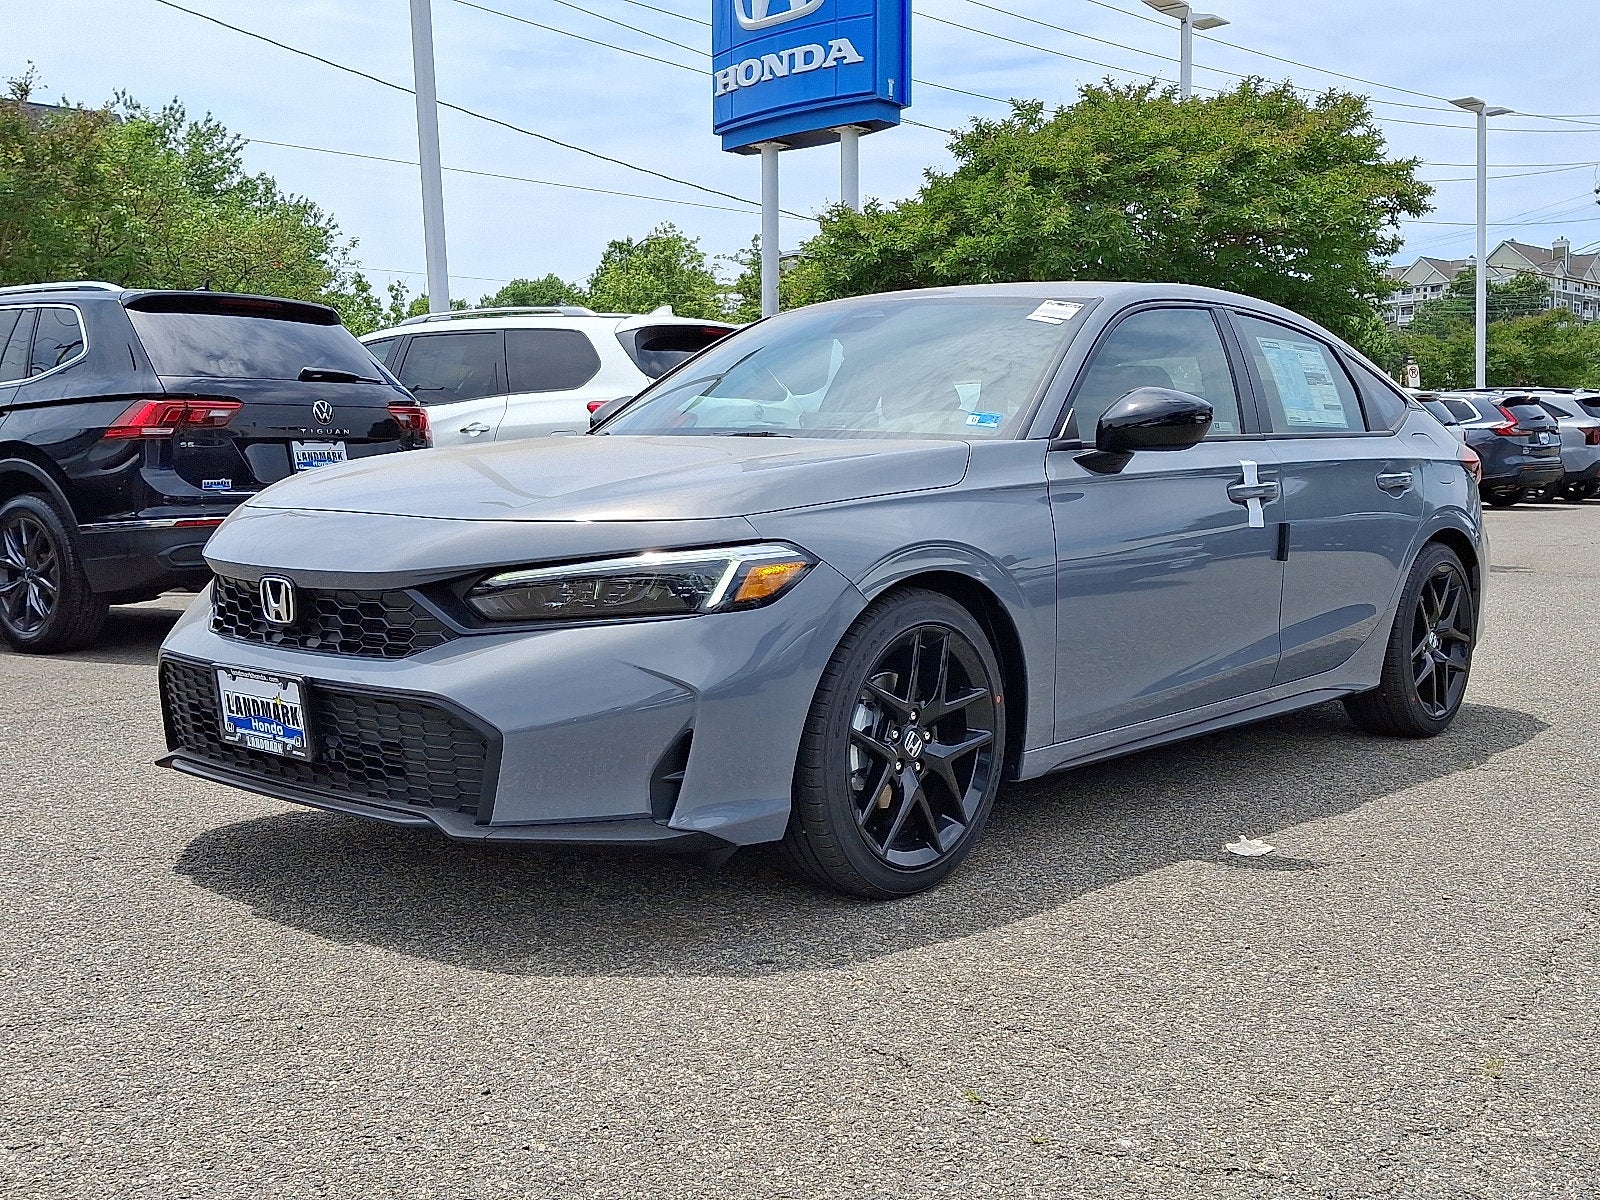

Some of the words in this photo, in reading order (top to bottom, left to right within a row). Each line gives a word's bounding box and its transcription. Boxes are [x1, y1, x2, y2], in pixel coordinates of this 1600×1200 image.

[714, 38, 864, 96] HONDA
[296, 451, 344, 462] LANDMARK
[225, 692, 301, 728] LANDMARK
[251, 718, 284, 736] Honda
[246, 735, 284, 755] LANDMARK
